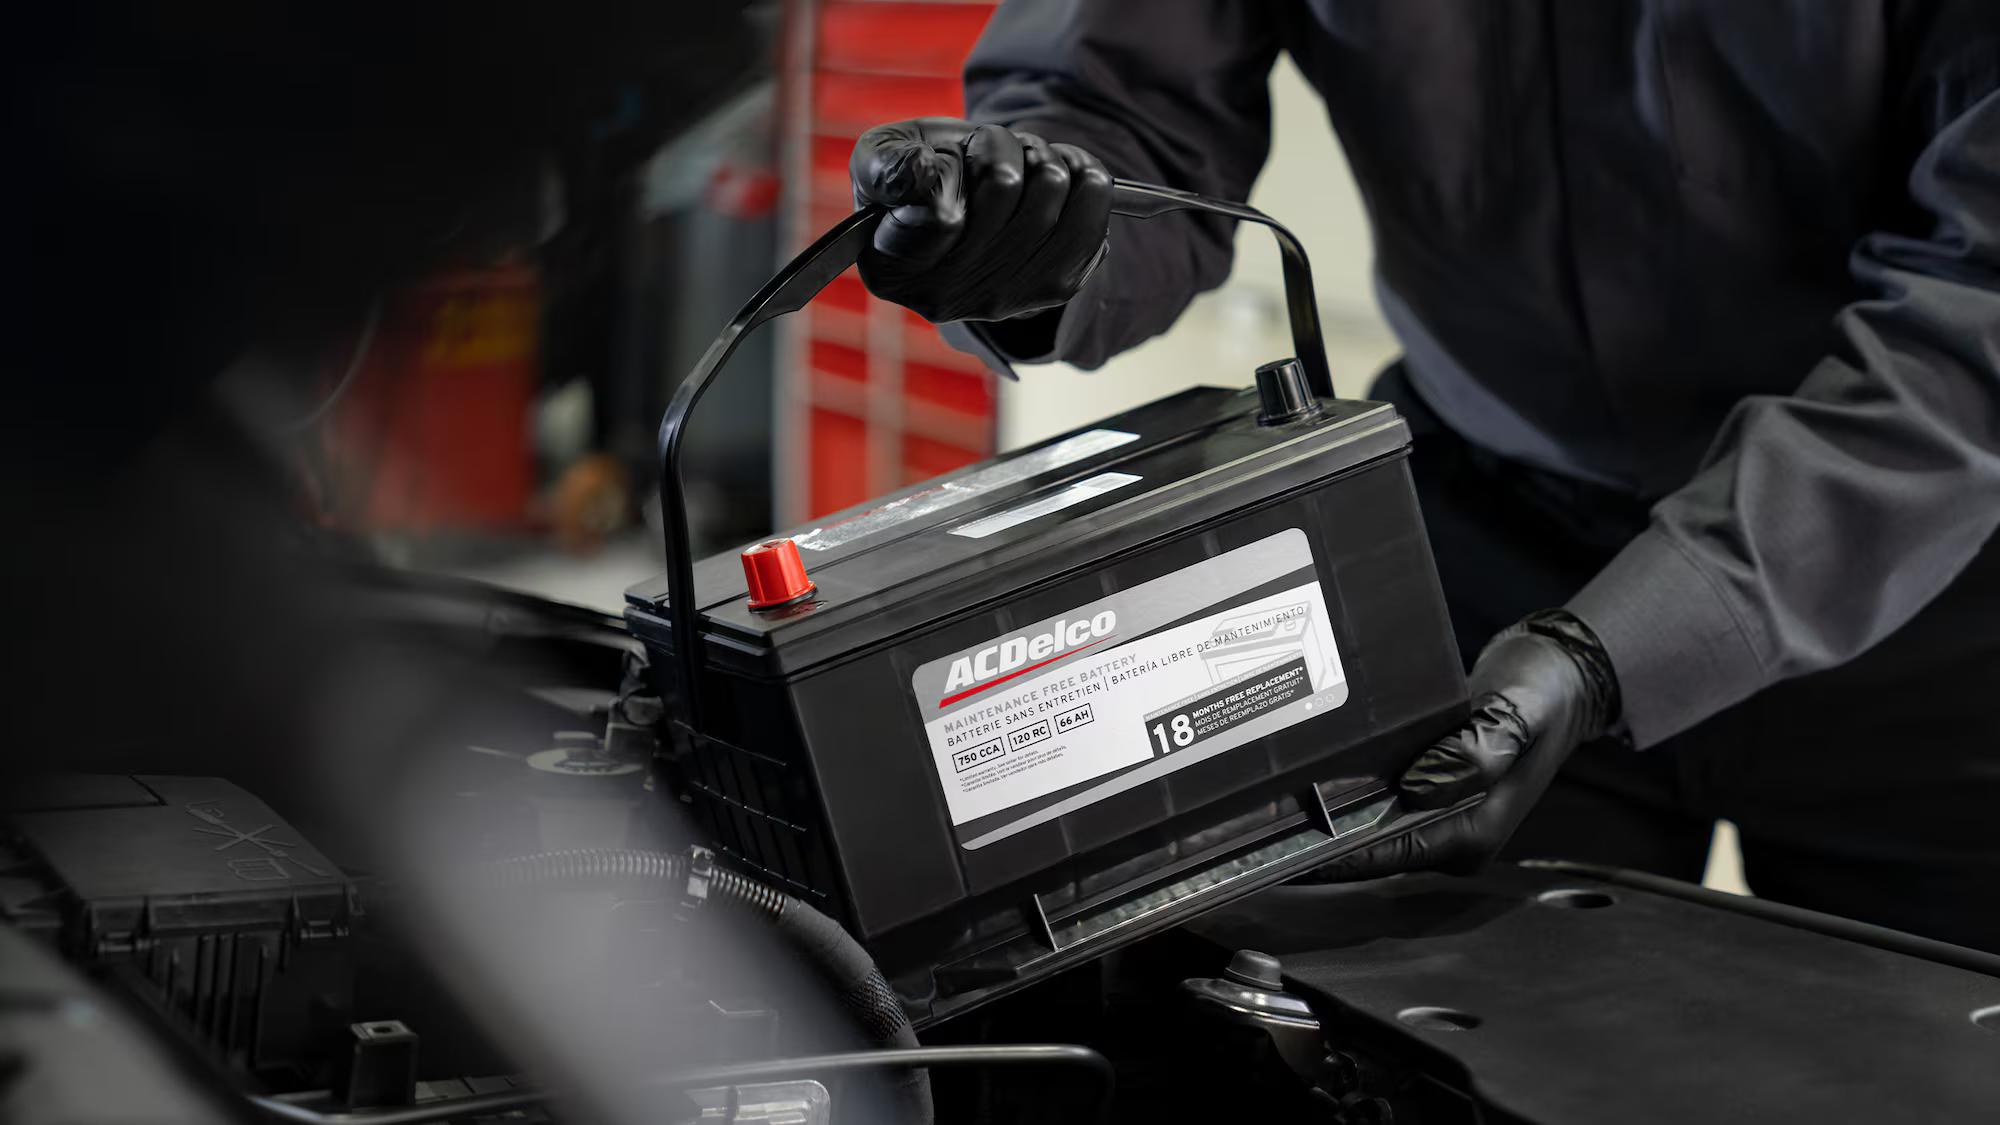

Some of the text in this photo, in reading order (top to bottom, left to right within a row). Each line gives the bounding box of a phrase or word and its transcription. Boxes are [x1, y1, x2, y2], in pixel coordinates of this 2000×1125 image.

[943, 610, 1117, 694] ACDelco
[1112, 606, 1304, 685] BATERÍA LIBRE DE MANTENIMIENTO
[944, 654, 1137, 734] MAINTENANCE FREE BATTERY
[1193, 695, 1225, 719] MONTHS
[1225, 691, 1245, 705] FREE
[1195, 713, 1211, 727] MOIS
[1212, 710, 1221, 720] DE
[1222, 689, 1273, 716] REMPLACEMENT
[947, 682, 1101, 747] BATTERIE SANS ENTRETIEN
[1060, 710, 1089, 728] 66 AH
[1197, 722, 1219, 736] MESES
[1219, 718, 1229, 727] DE
[1229, 701, 1268, 724] REEMPLAZO
[1012, 726, 1047, 746] 120 RC
[1153, 714, 1194, 754] 18
[957, 744, 1001, 766] 750 CCA
